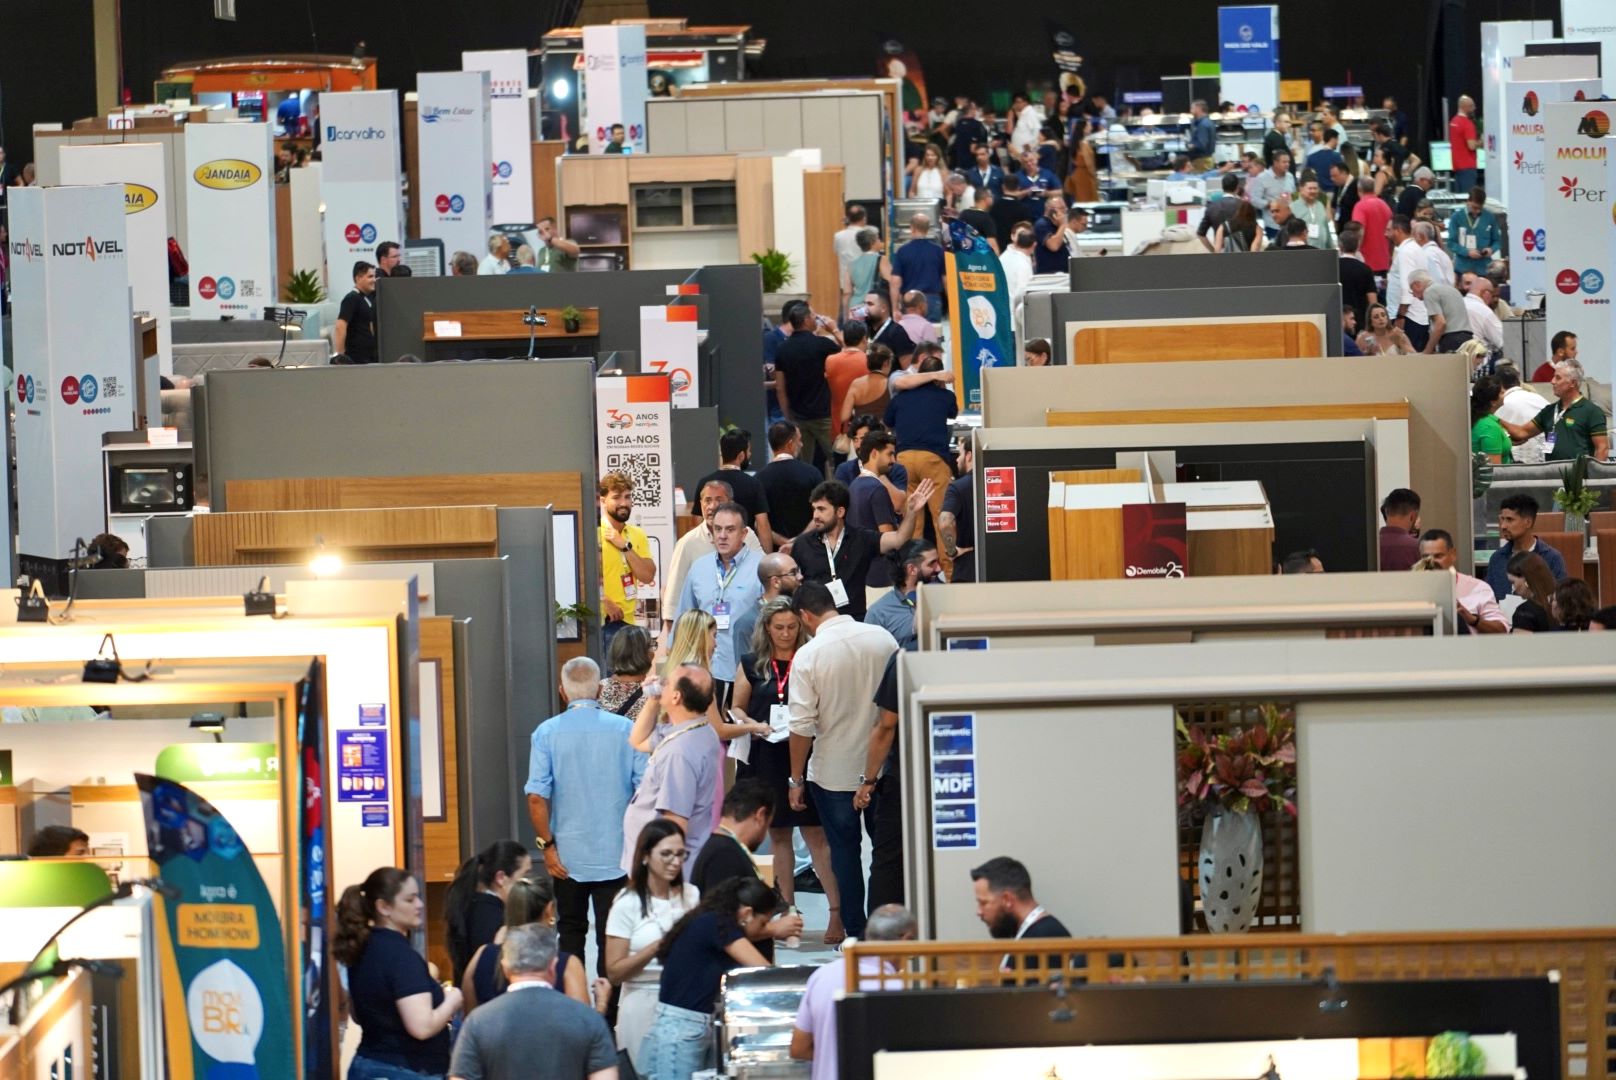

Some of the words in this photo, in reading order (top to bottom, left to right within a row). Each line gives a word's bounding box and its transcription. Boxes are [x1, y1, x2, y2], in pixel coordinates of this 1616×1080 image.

[205, 169, 251, 179] JANDAIA
[606, 435, 660, 445] SIGA-NOS
[934, 778, 973, 793] MDF
